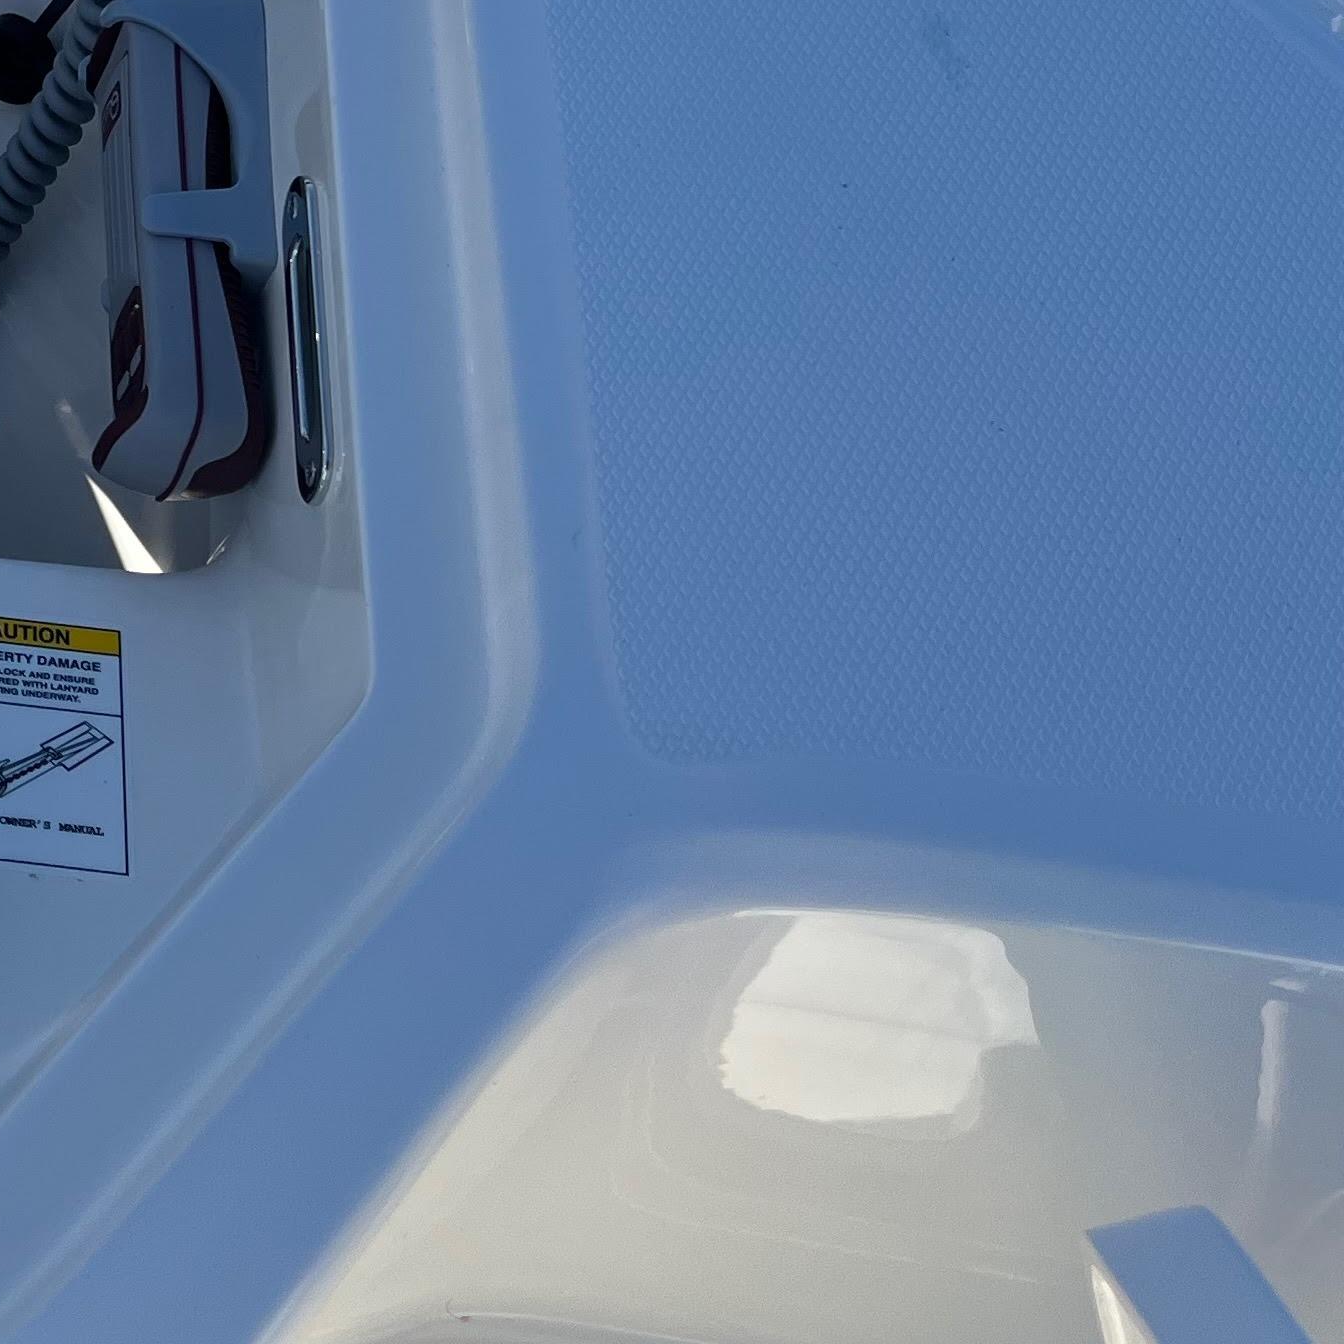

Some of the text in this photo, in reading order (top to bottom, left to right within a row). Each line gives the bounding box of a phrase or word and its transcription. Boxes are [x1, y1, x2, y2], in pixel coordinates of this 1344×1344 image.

[36, 655, 101, 672] DAMAGE
[28, 670, 51, 680] AND
[53, 673, 94, 685] ENSURE
[21, 679, 47, 689] WITH
[50, 682, 98, 695] LANYARD
[58, 823, 104, 836] MANUAL
